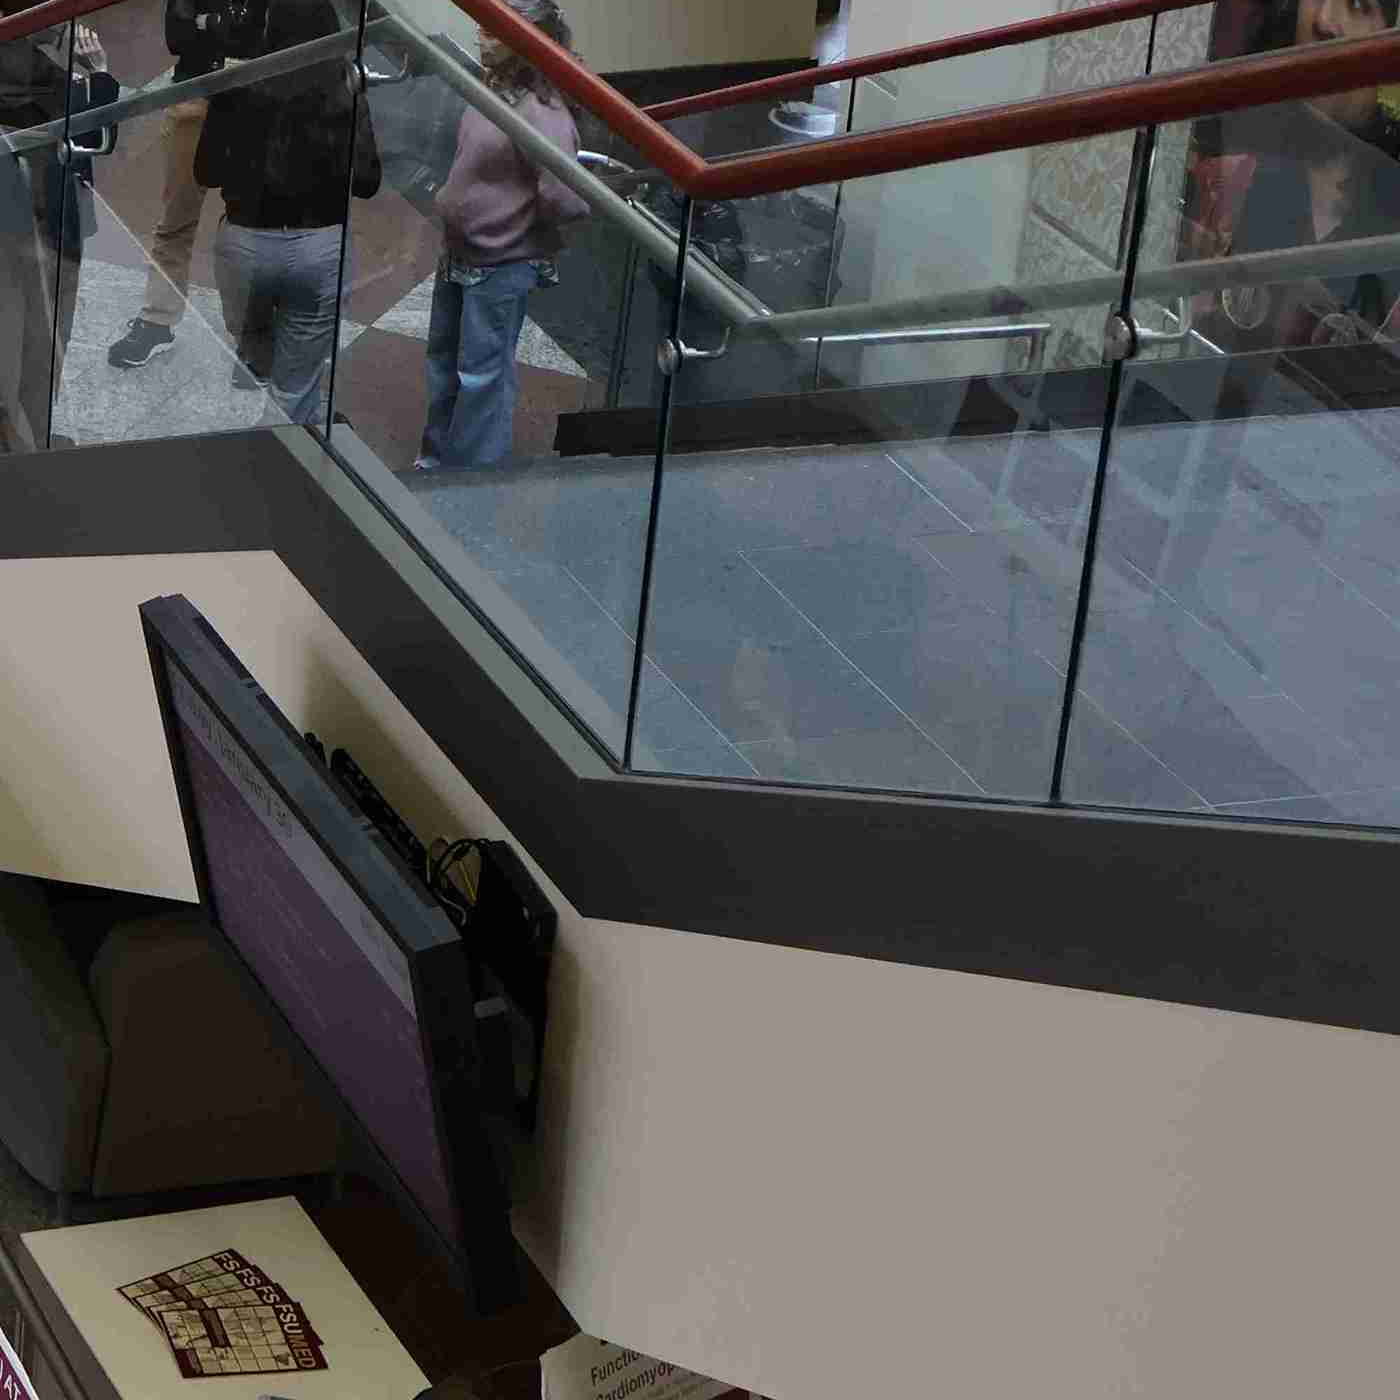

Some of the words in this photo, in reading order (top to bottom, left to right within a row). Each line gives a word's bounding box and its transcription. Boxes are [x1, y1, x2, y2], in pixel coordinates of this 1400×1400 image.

[214, 1252, 241, 1272] FS
[237, 1268, 263, 1288] FS
[256, 1285, 281, 1305] FS
